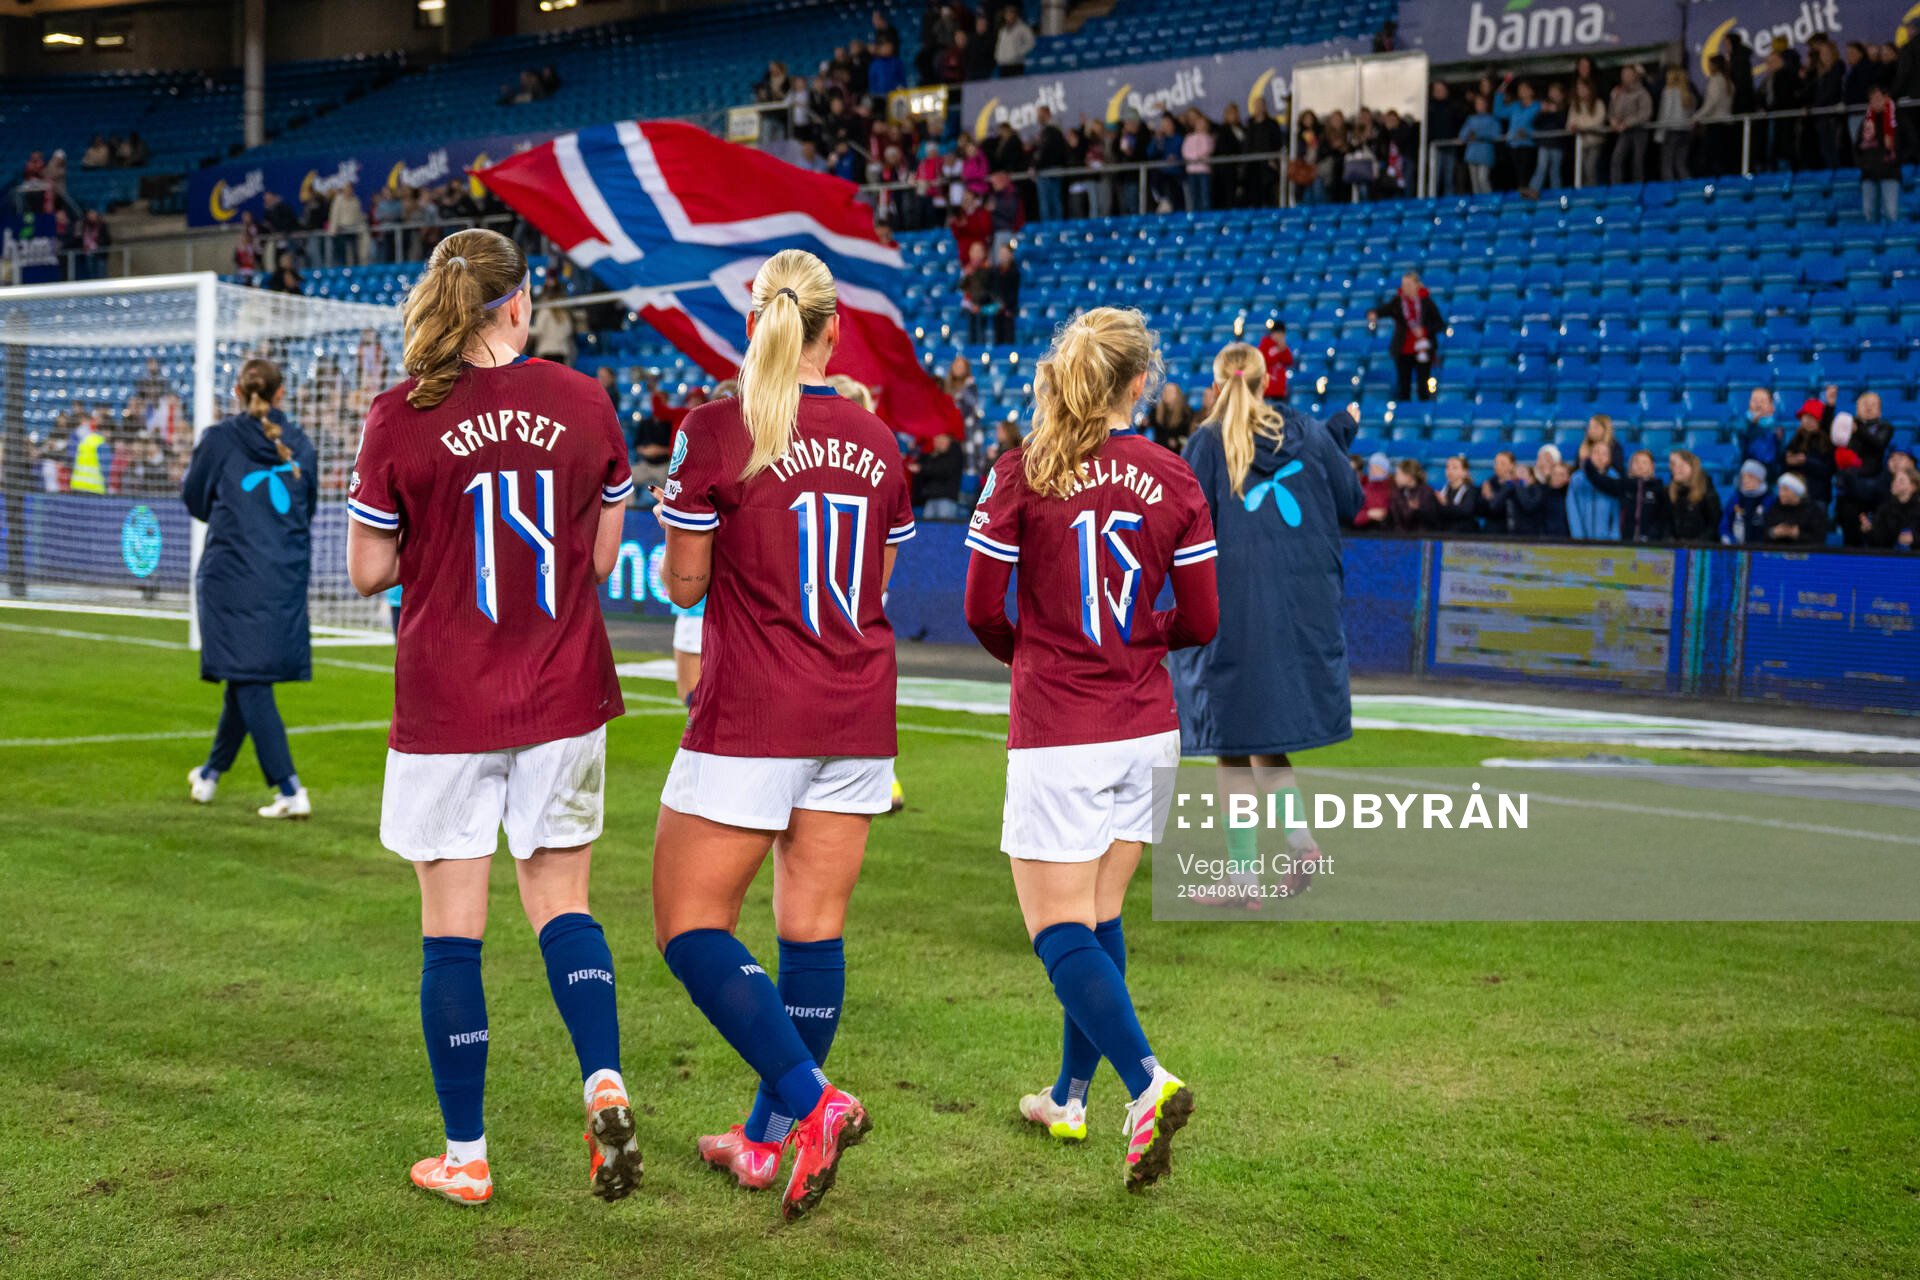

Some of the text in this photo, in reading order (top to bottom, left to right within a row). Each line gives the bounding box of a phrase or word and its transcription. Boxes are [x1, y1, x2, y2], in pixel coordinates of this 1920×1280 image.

[1467, 2, 1604, 56] bama
[440, 409, 566, 457] GRUPSET
[1050, 459, 1163, 505] ELLAND
[463, 469, 556, 624] 14
[788, 491, 868, 638] 10
[1068, 510, 1143, 647] 15
[568, 968, 614, 985] NORGE
[785, 1005, 836, 1019] NORGE
[449, 1029, 489, 1048] NORG
